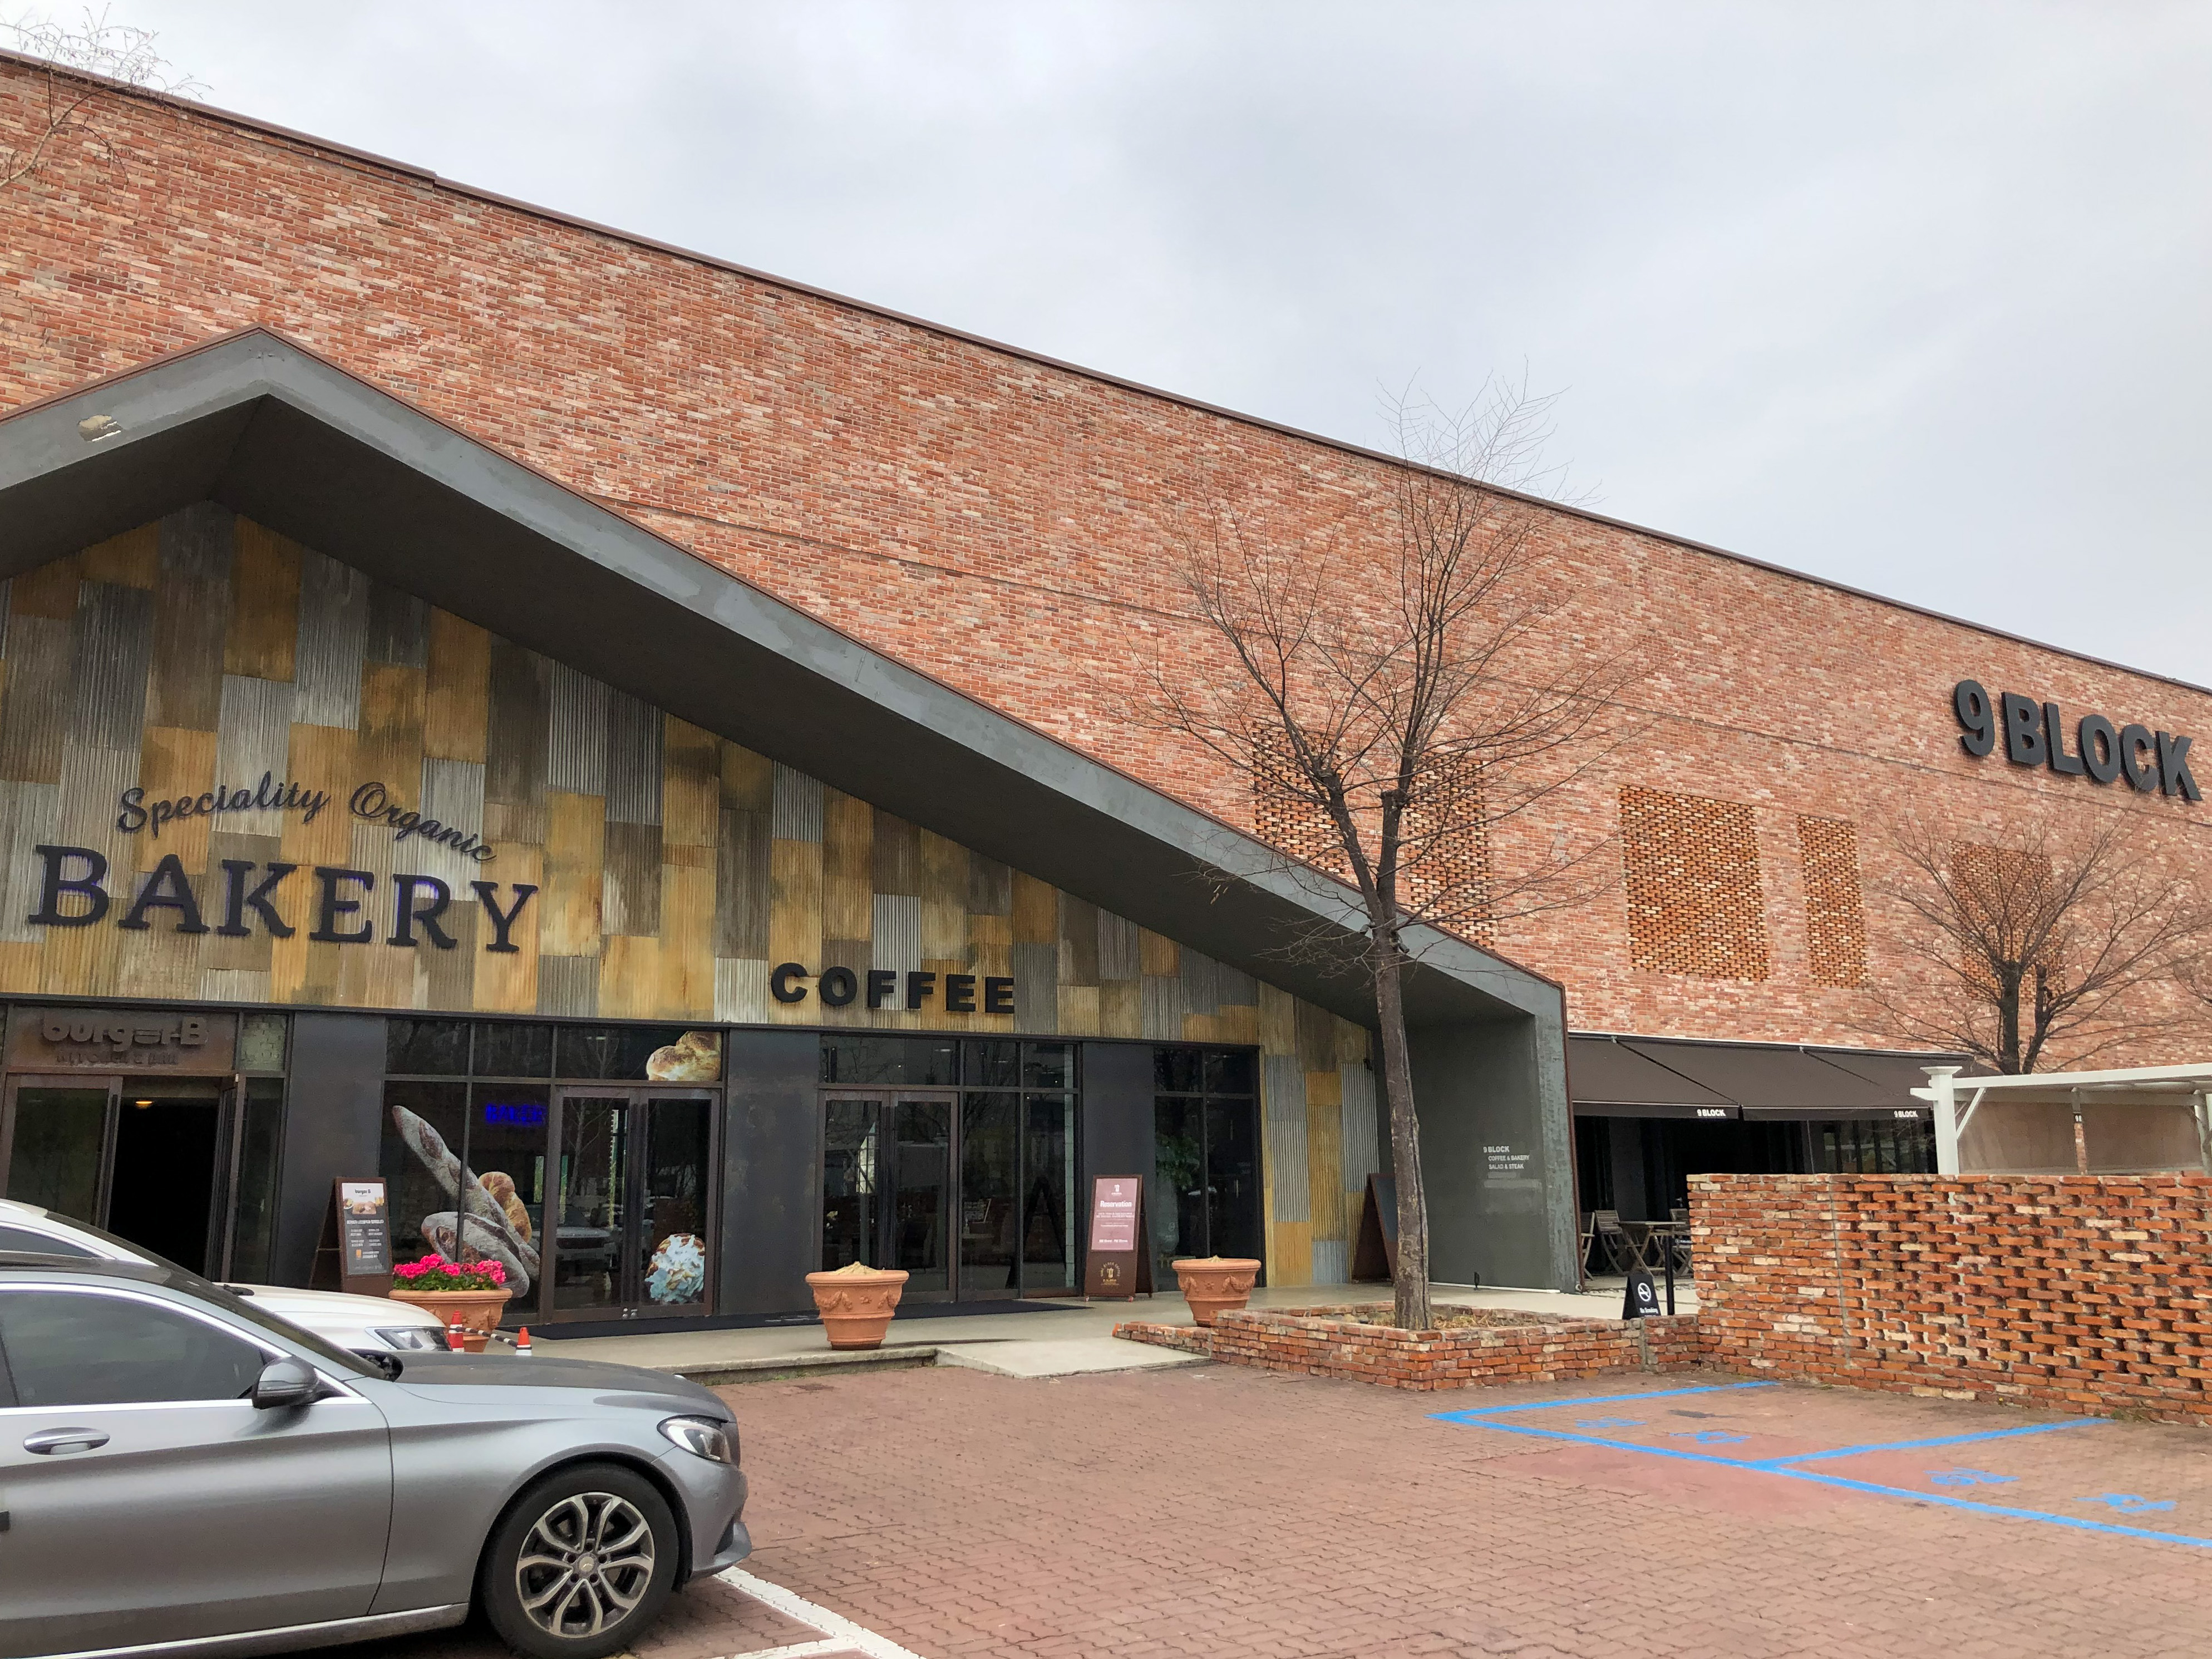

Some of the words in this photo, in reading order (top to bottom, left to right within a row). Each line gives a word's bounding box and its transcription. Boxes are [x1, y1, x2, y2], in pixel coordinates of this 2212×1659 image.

[1955, 679, 1995, 756] 9
[2001, 691, 2204, 801] BLOCK
[117, 770, 332, 839] Speciality
[349, 781, 497, 864] Organic
[28, 844, 539, 953] BAKERY
[771, 962, 1015, 1013] COFFEE
